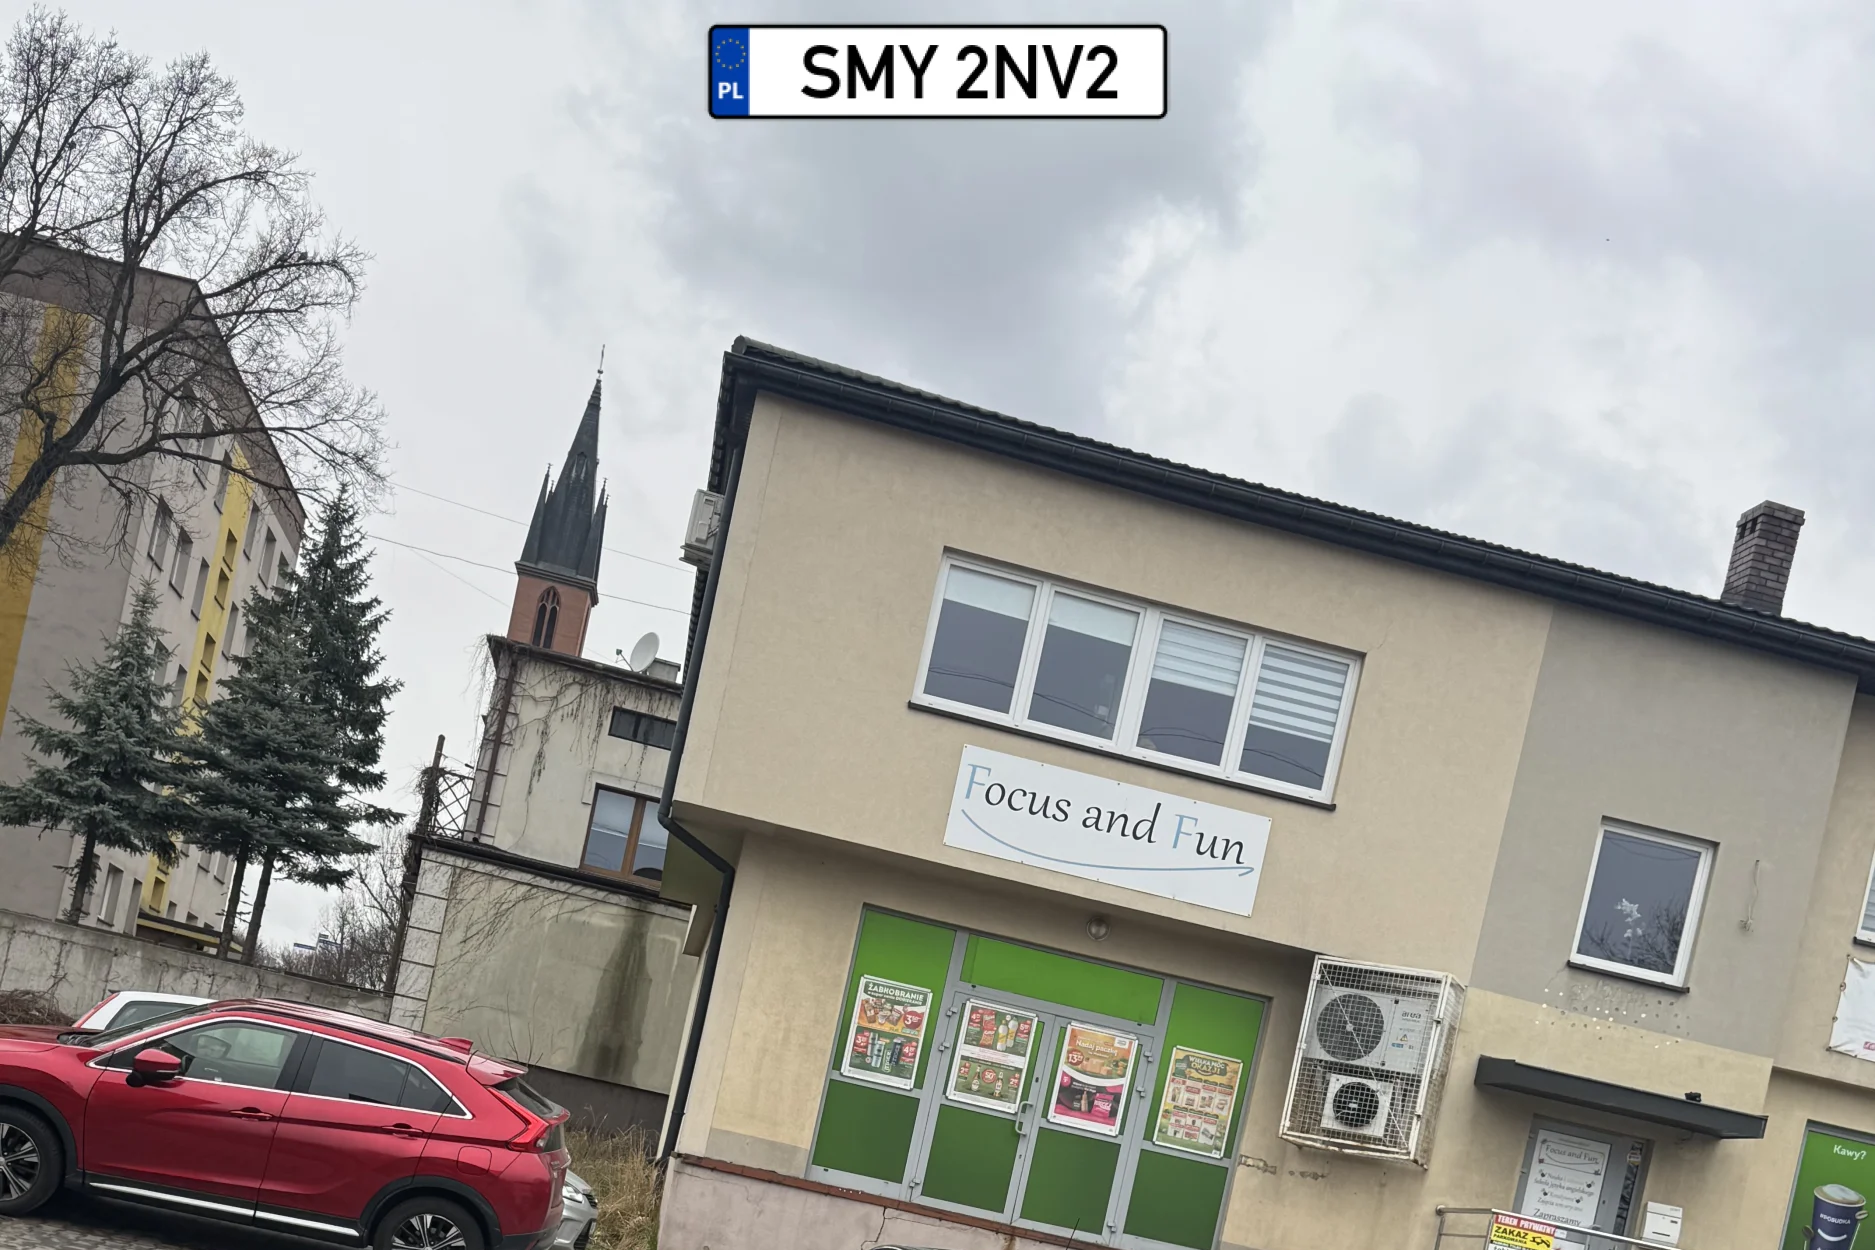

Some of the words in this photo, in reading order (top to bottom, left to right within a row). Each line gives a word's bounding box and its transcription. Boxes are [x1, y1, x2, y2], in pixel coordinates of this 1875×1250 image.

[964, 763, 1072, 823] Focus
[1081, 802, 1163, 844] and
[1172, 813, 1245, 865] Fun
[1833, 1144, 1867, 1161] Kawy?
[1533, 1208, 1582, 1226] Zapraszamy
[1494, 1226, 1529, 1240] ZAKAZ
